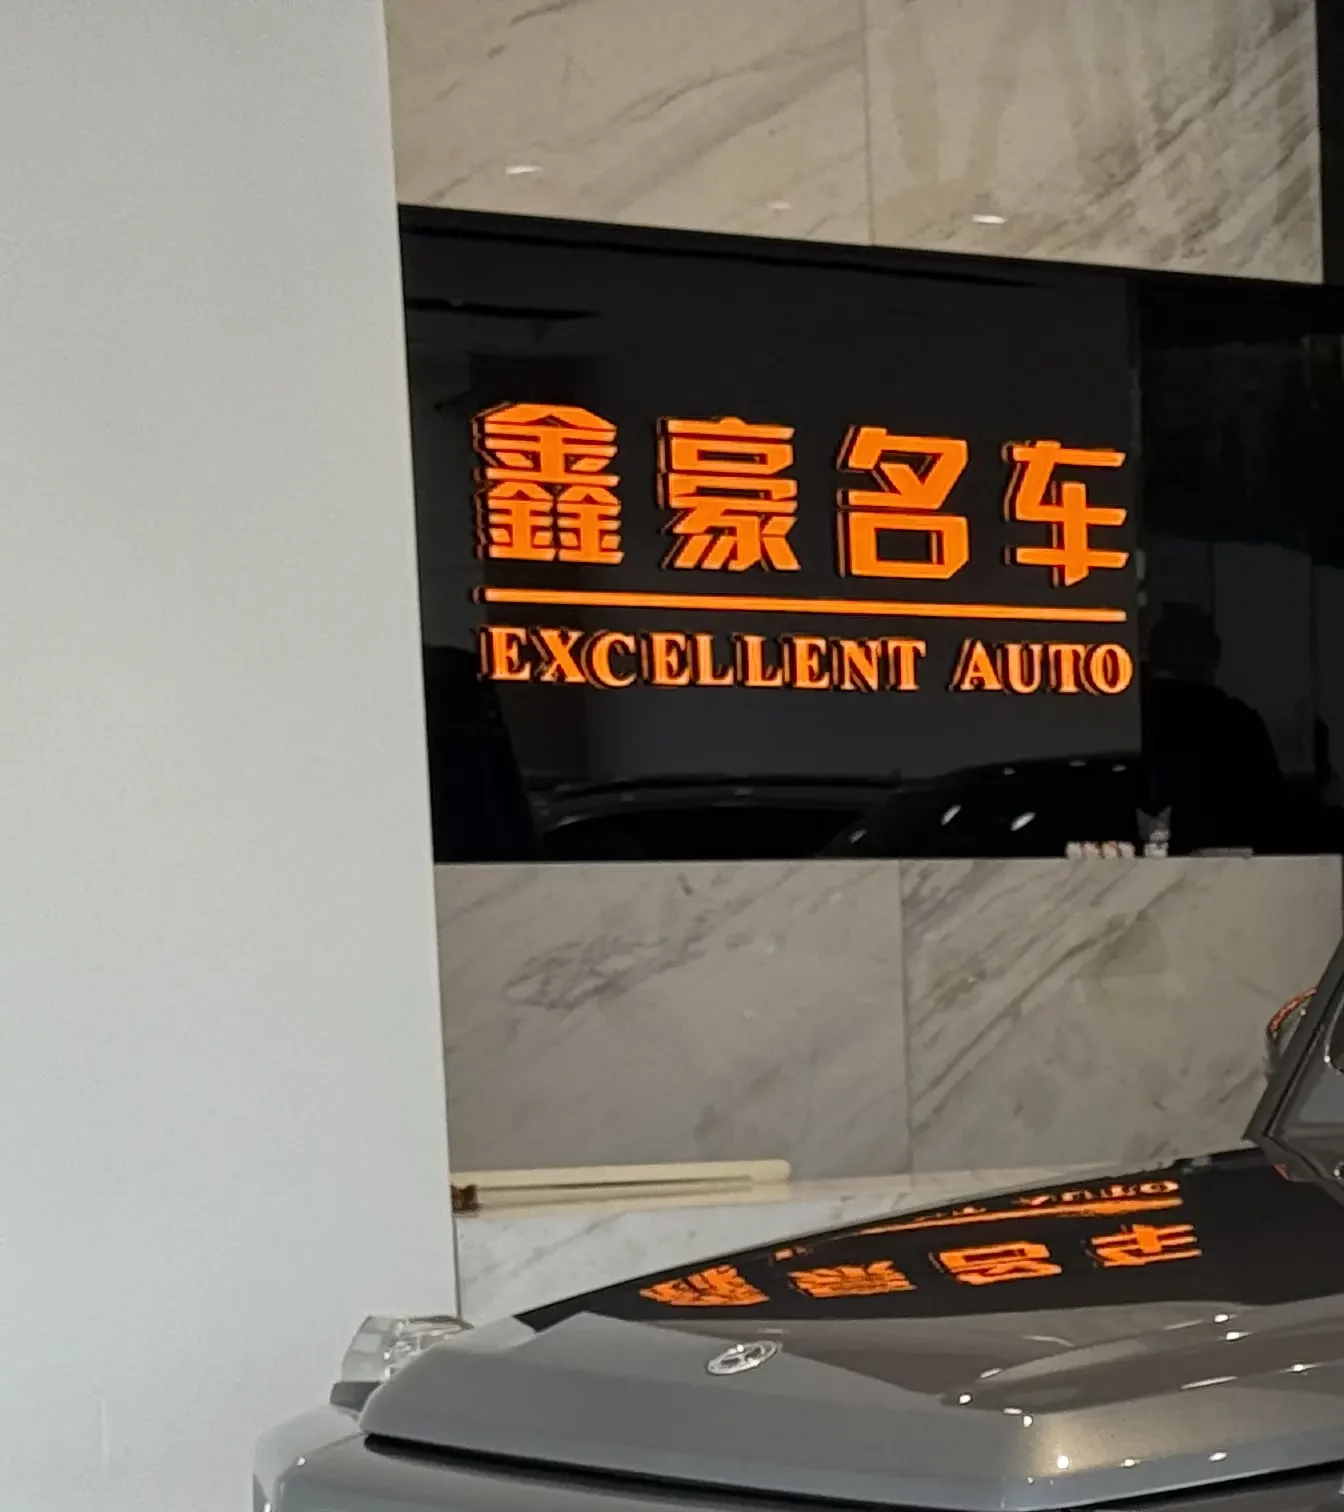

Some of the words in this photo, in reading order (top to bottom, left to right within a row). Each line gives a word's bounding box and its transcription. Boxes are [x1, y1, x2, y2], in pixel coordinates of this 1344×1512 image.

[476, 403, 1130, 588] 鑫豪名车
[480, 625, 926, 692] EXCELLENT
[954, 639, 1134, 695] AUTO
